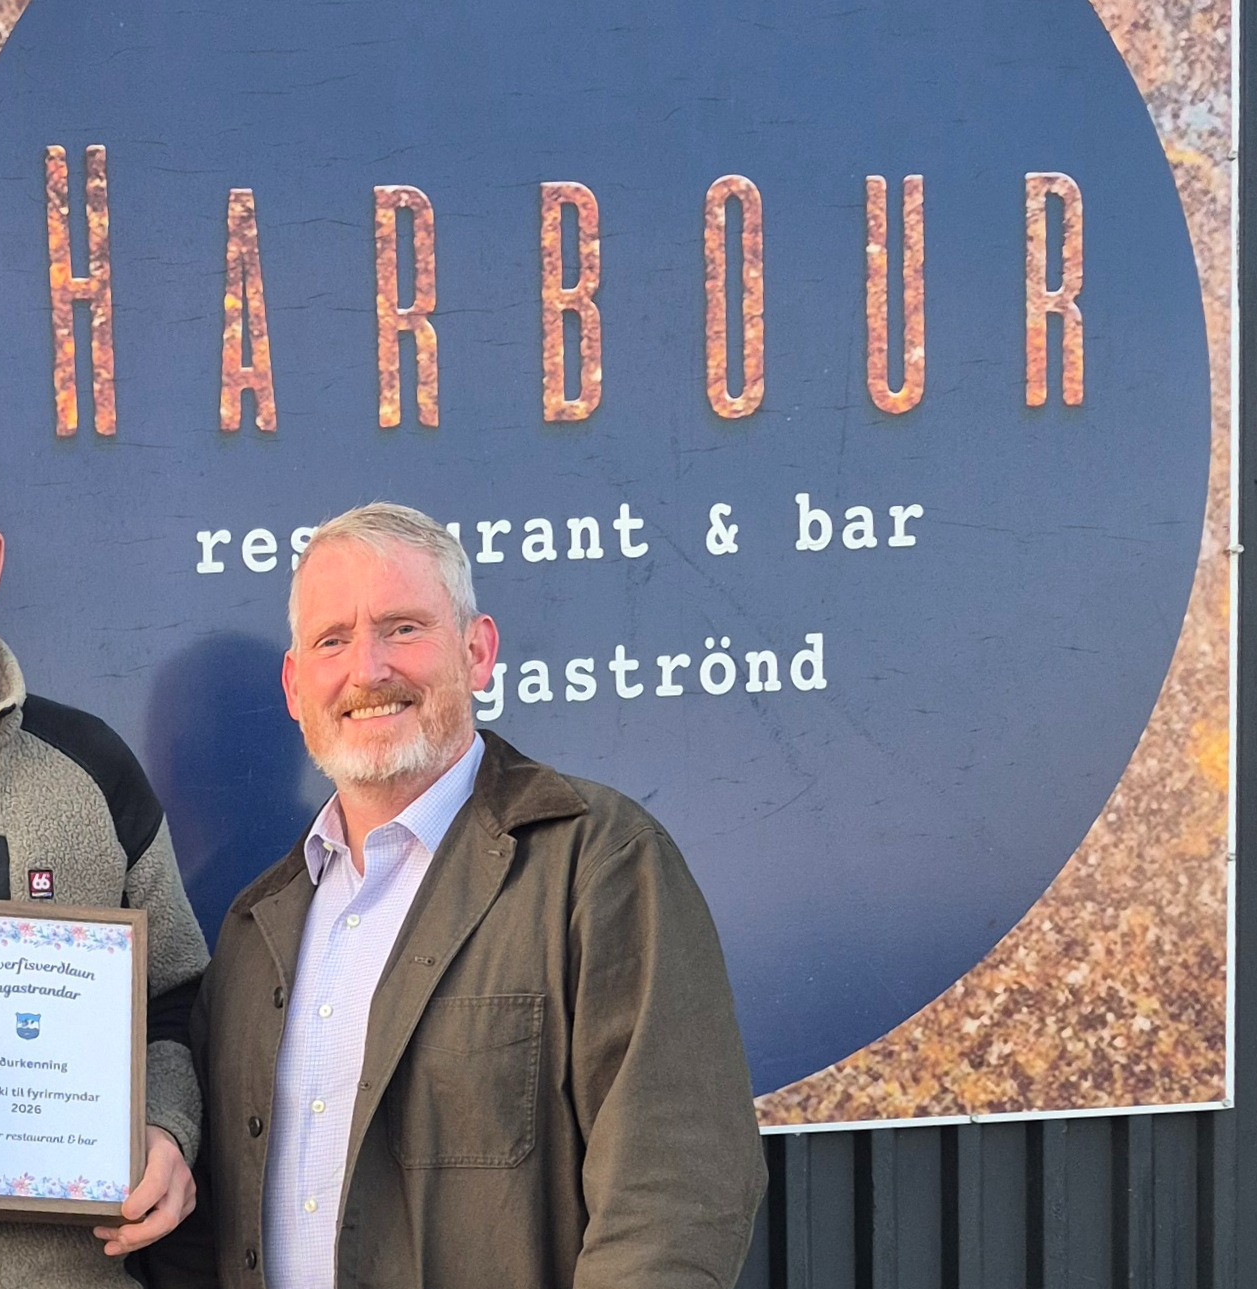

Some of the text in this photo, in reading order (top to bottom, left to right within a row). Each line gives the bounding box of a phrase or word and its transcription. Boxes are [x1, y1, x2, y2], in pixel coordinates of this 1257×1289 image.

[45, 144, 1085, 438] HARBOUR
[195, 493, 925, 574] resrant & bar
[472, 632, 828, 722] gaströnd
[11, 1086, 25, 1098] til
[27, 1087, 101, 1103] fyrirmyndar
[11, 1103, 42, 1115] 2026
[5, 1132, 65, 1144] restaurant
[67, 1134, 76, 1145] &
[77, 1134, 98, 1146] bar
